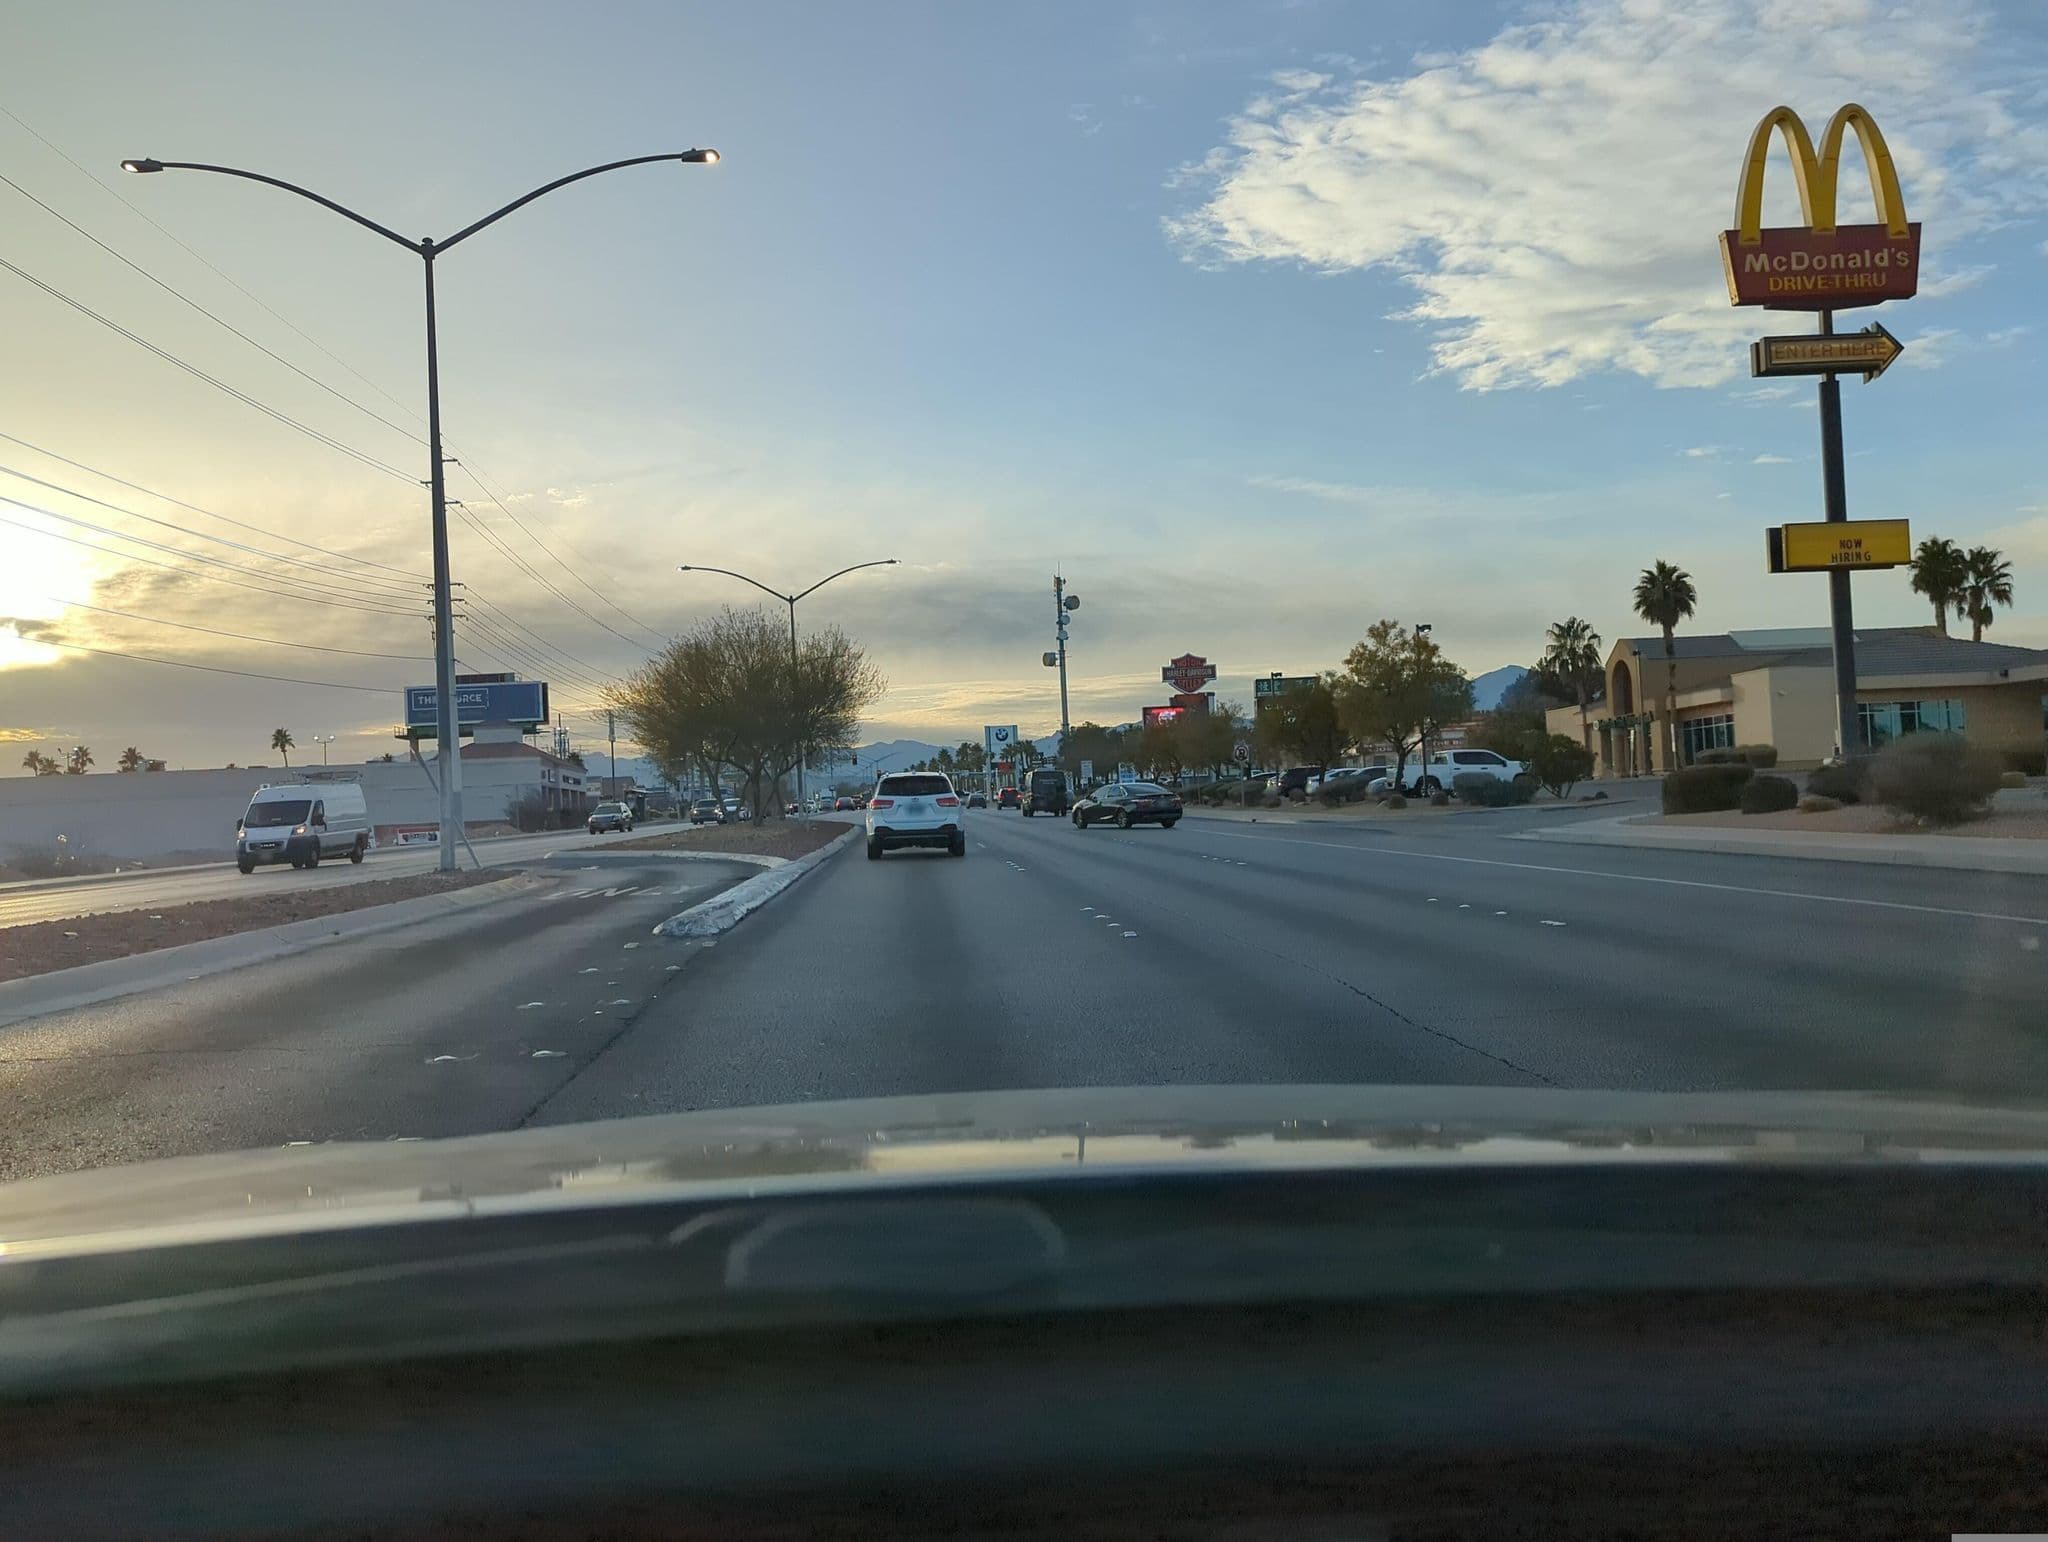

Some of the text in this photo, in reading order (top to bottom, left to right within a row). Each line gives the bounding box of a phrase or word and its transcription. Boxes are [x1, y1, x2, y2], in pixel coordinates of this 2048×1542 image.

[1744, 248, 1910, 272] McDonald's
[1768, 272, 1887, 292] DRIVE-THRU
[1774, 341, 1889, 359] ENTER HERE
[1839, 538, 1863, 550] NOW
[1831, 551, 1872, 563] HIRING
